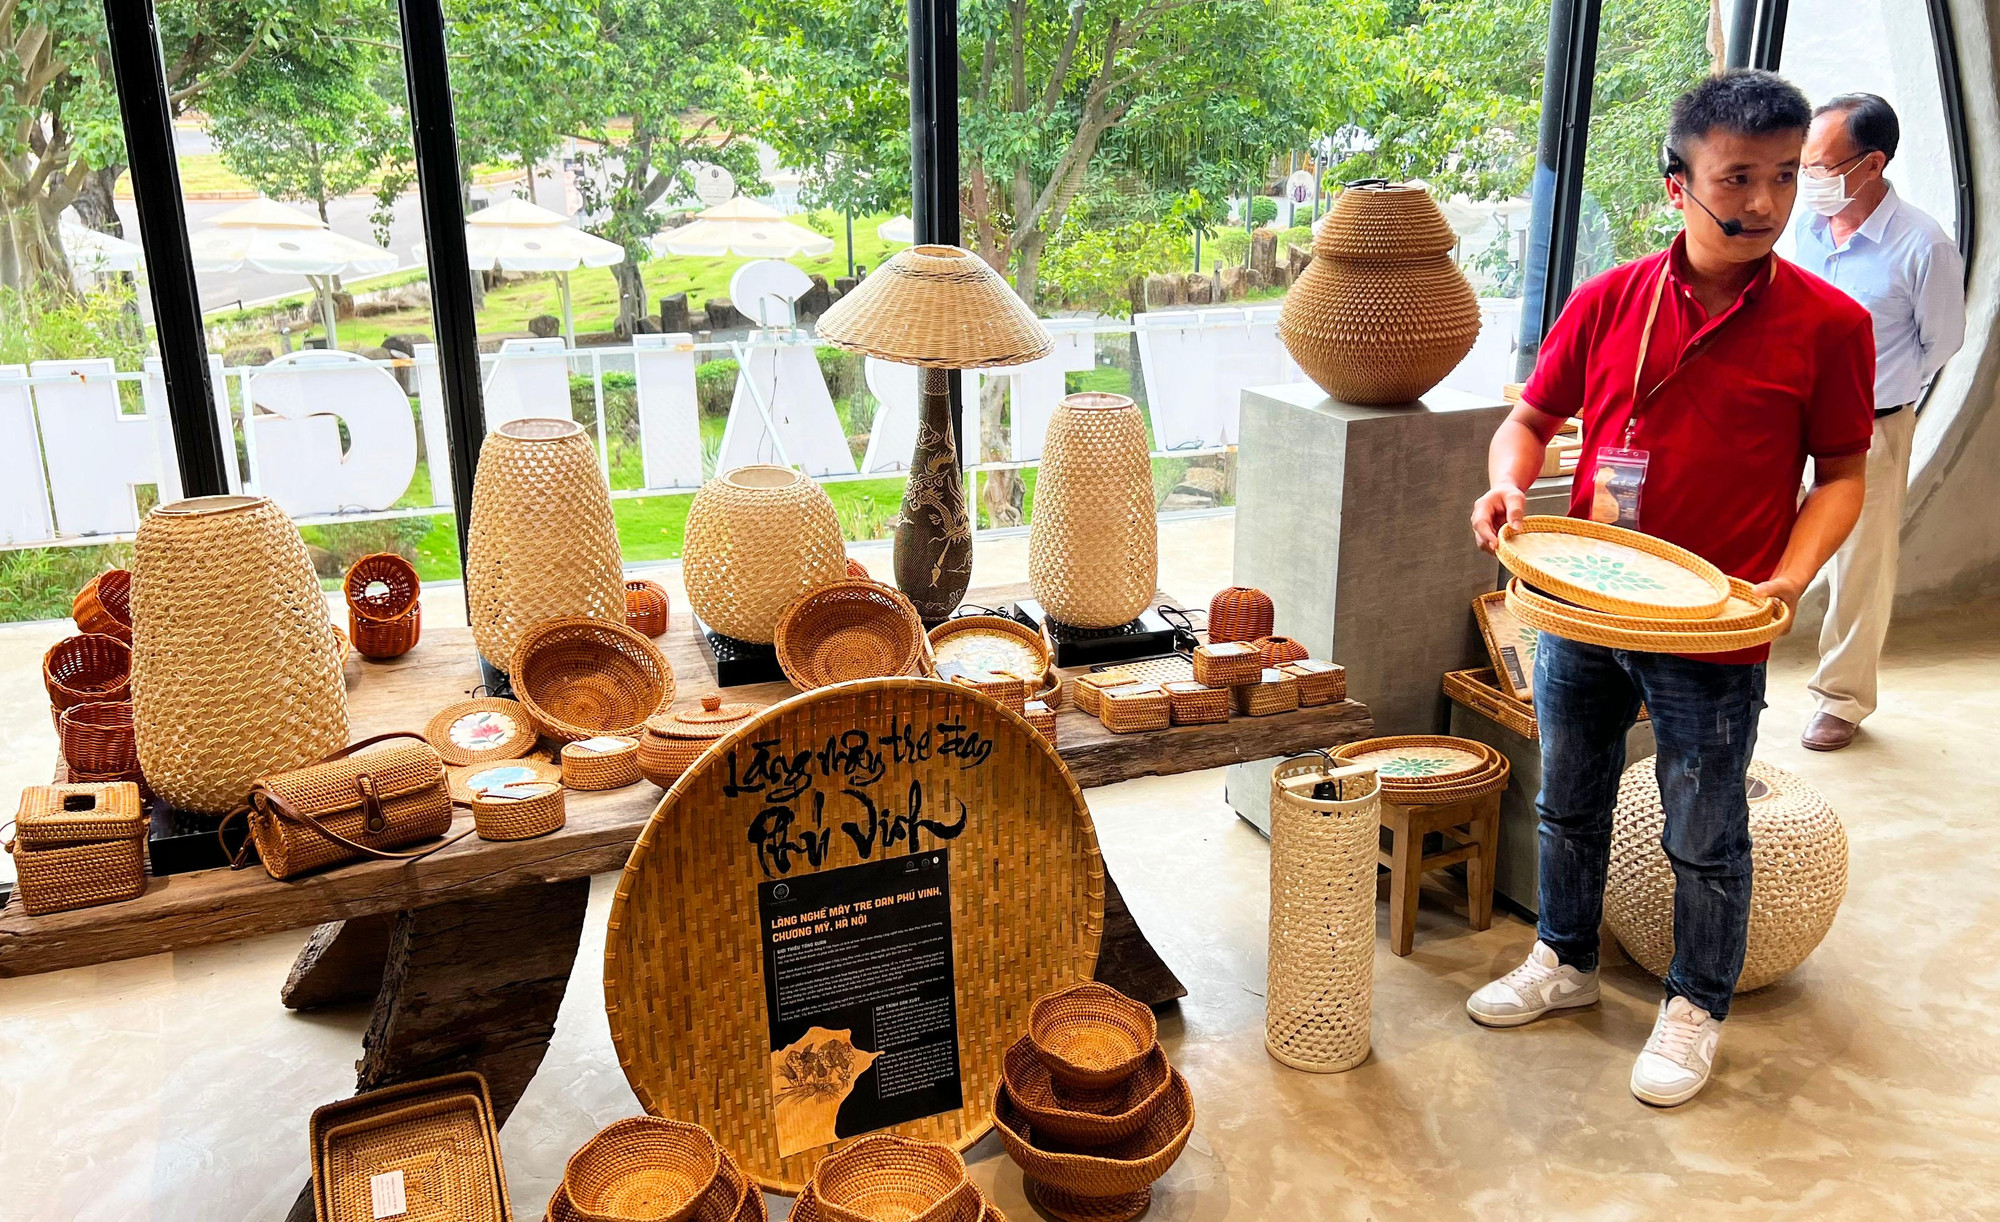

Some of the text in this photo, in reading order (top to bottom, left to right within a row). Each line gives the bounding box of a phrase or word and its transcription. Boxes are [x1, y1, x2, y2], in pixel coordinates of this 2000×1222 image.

[879, 715, 934, 764] tre
[840, 779, 967, 860] Vinh
[771, 886, 942, 930] LÀNG NGHỀ MÂY TRE ĐAN PHÚ VINH,
[772, 924, 812, 942] CHƯƠNG
[835, 915, 849, 930] HÀ
[851, 914, 867, 927] NỘI
